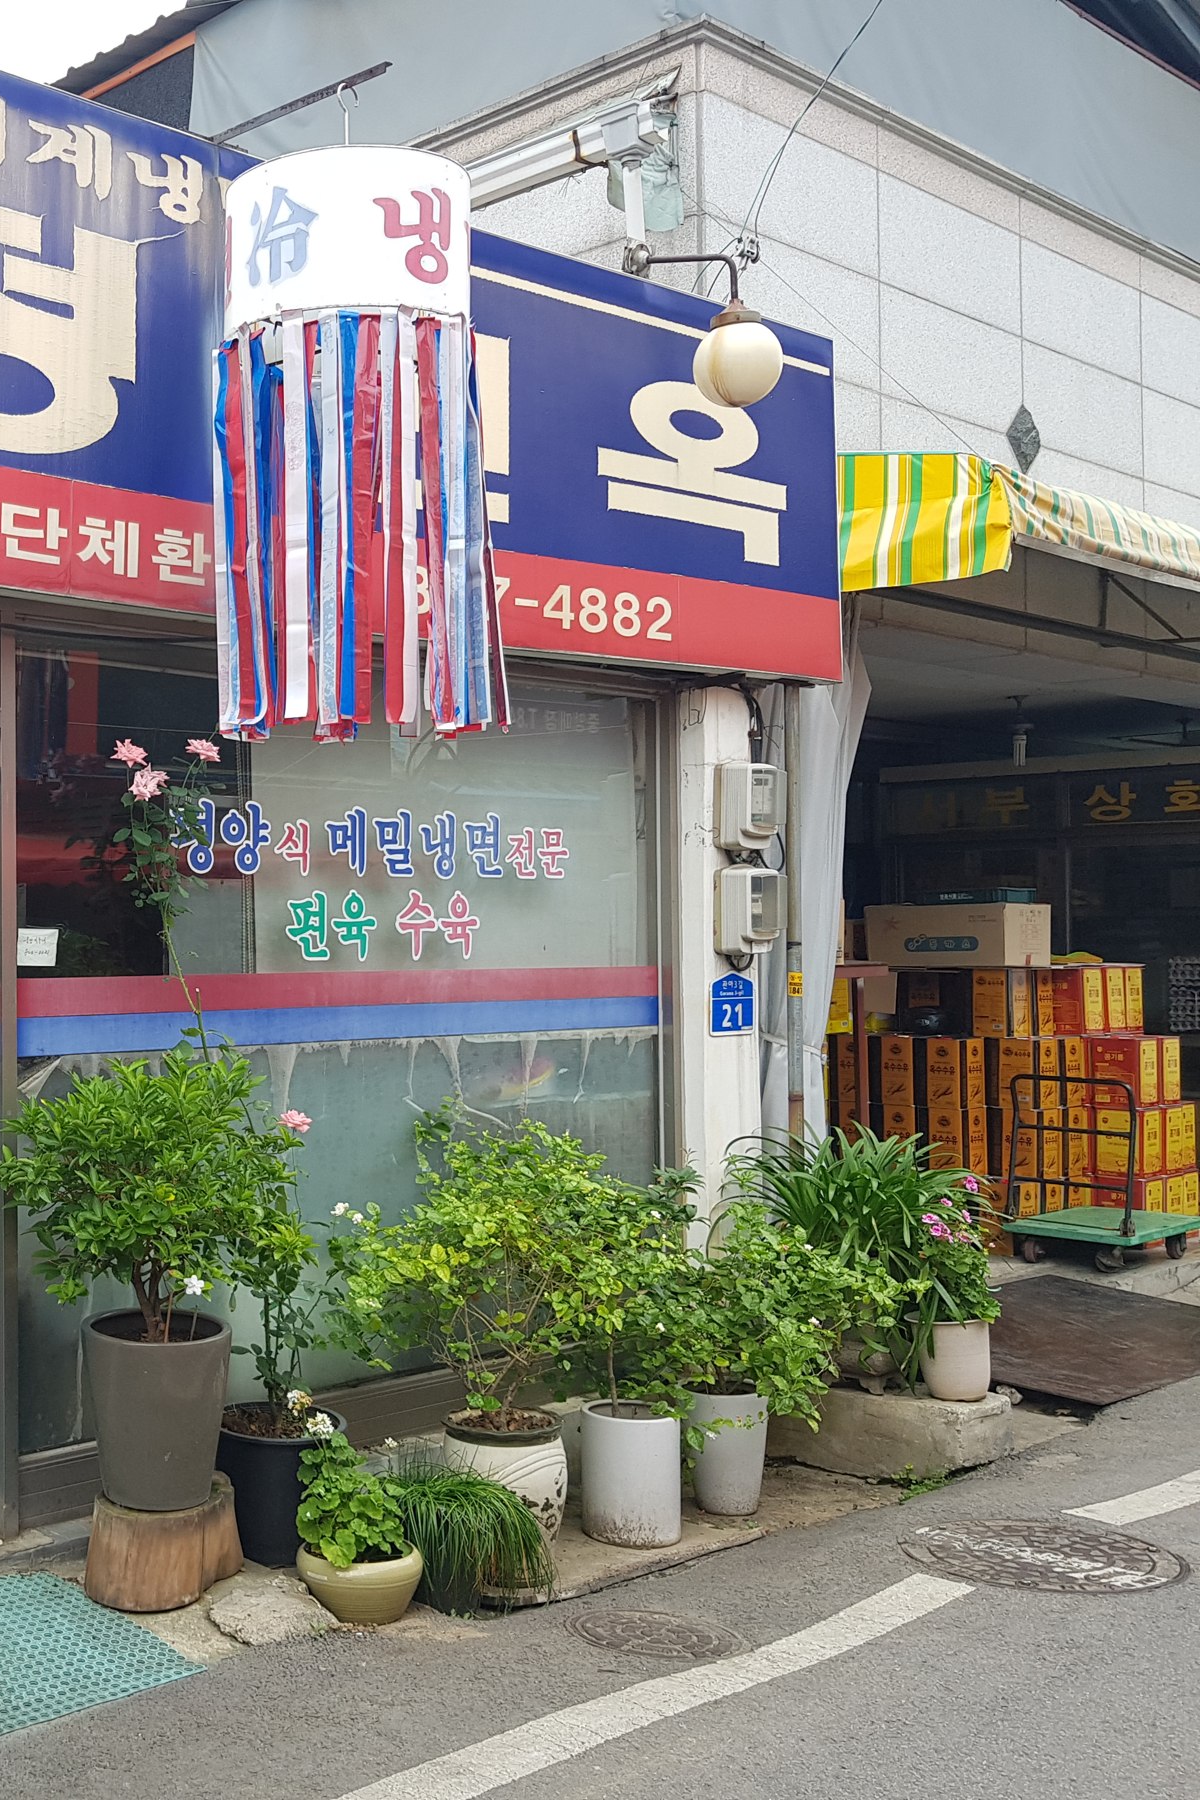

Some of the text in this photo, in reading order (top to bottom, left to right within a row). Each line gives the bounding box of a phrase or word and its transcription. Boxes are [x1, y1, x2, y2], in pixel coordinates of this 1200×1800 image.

[246, 185, 320, 288] 冷
[372, 187, 451, 285] 냉
[285, 889, 481, 962] 편육 수육
[722, 1003, 743, 1028] 21
